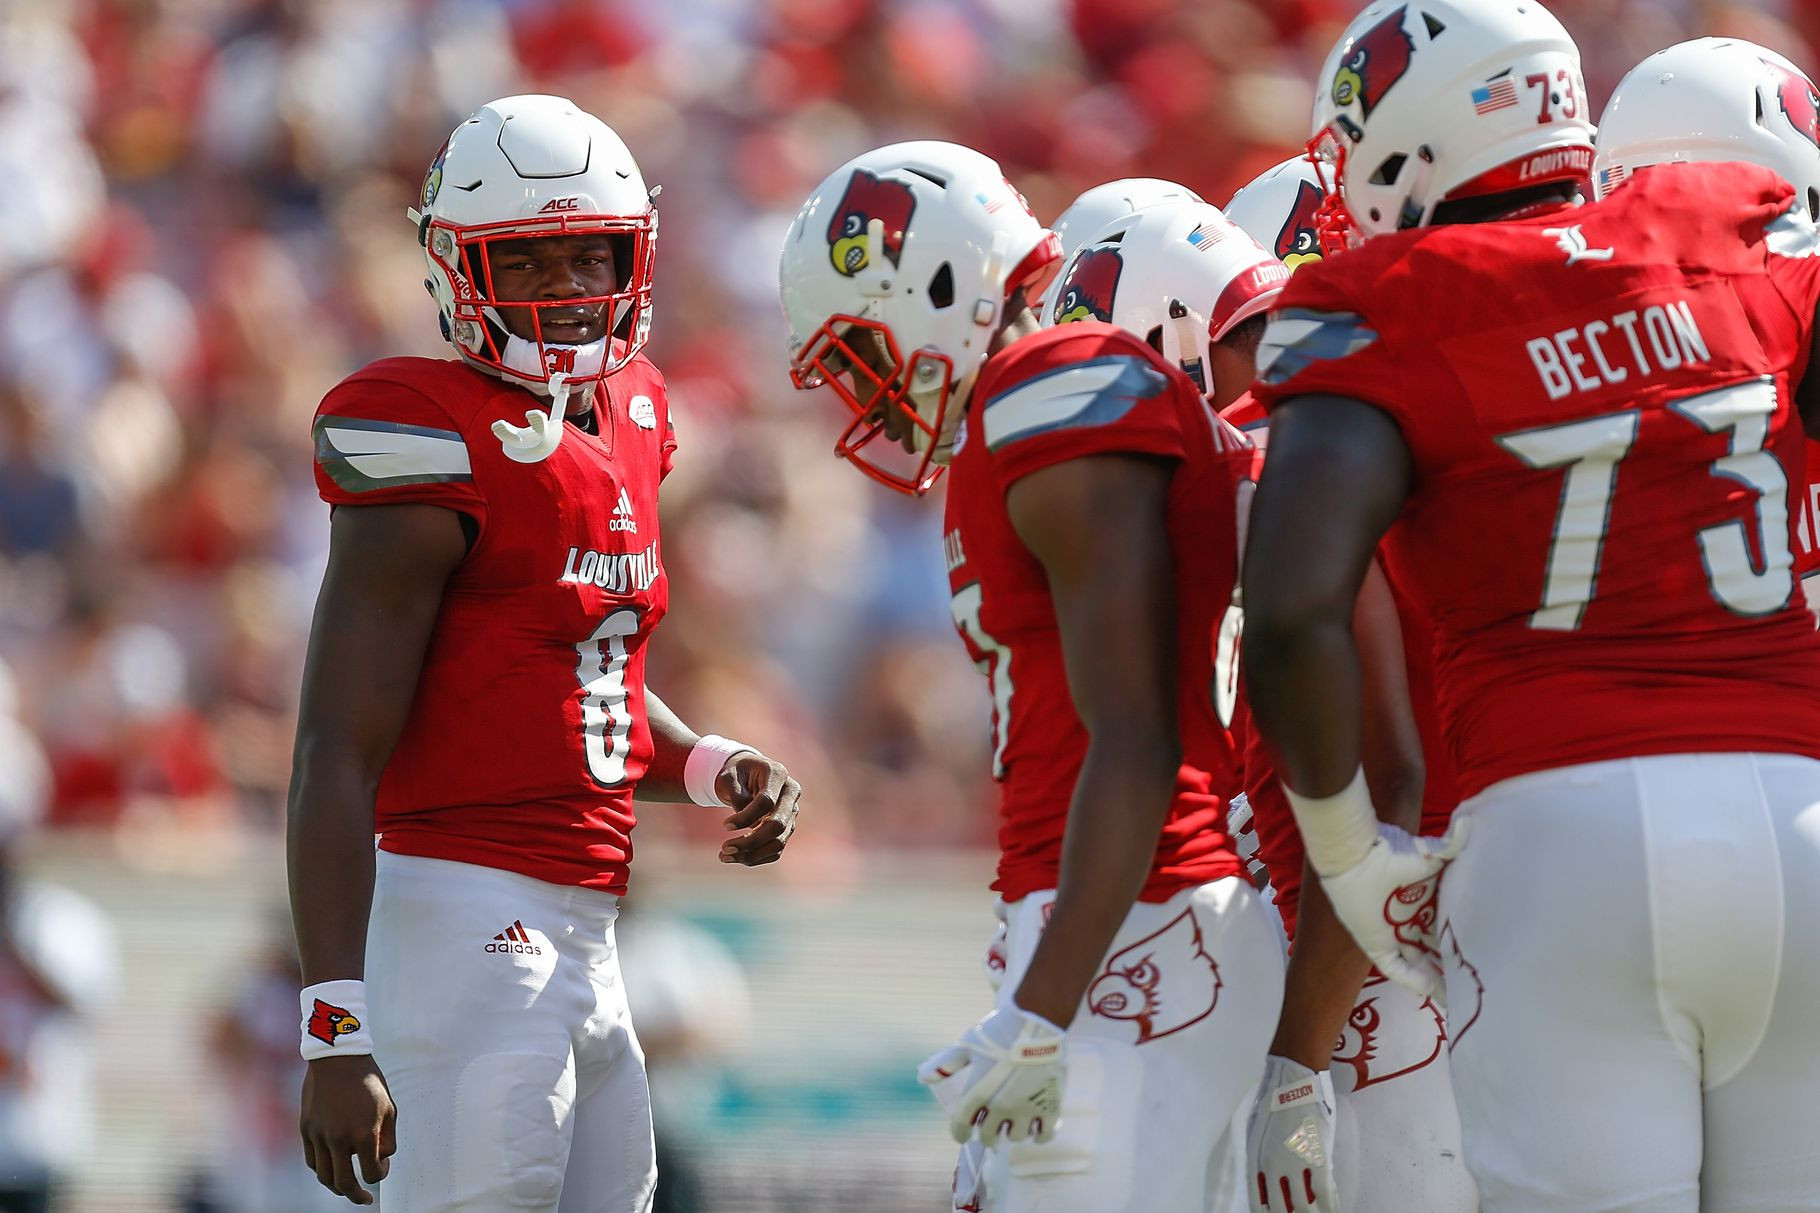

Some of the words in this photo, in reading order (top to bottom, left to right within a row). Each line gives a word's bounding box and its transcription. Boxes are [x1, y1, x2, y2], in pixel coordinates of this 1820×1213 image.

[1525, 69, 1576, 124] 73
[1519, 149, 1591, 180] LOUISVILLE
[539, 197, 579, 213] ACC
[1542, 224, 1614, 267] L
[1526, 301, 1711, 400] BECTON
[609, 514, 638, 535] adidas
[1493, 374, 1795, 631] 73
[560, 539, 660, 593] LOUISVILLE
[574, 607, 639, 787] 8
[484, 940, 542, 956] adidas
